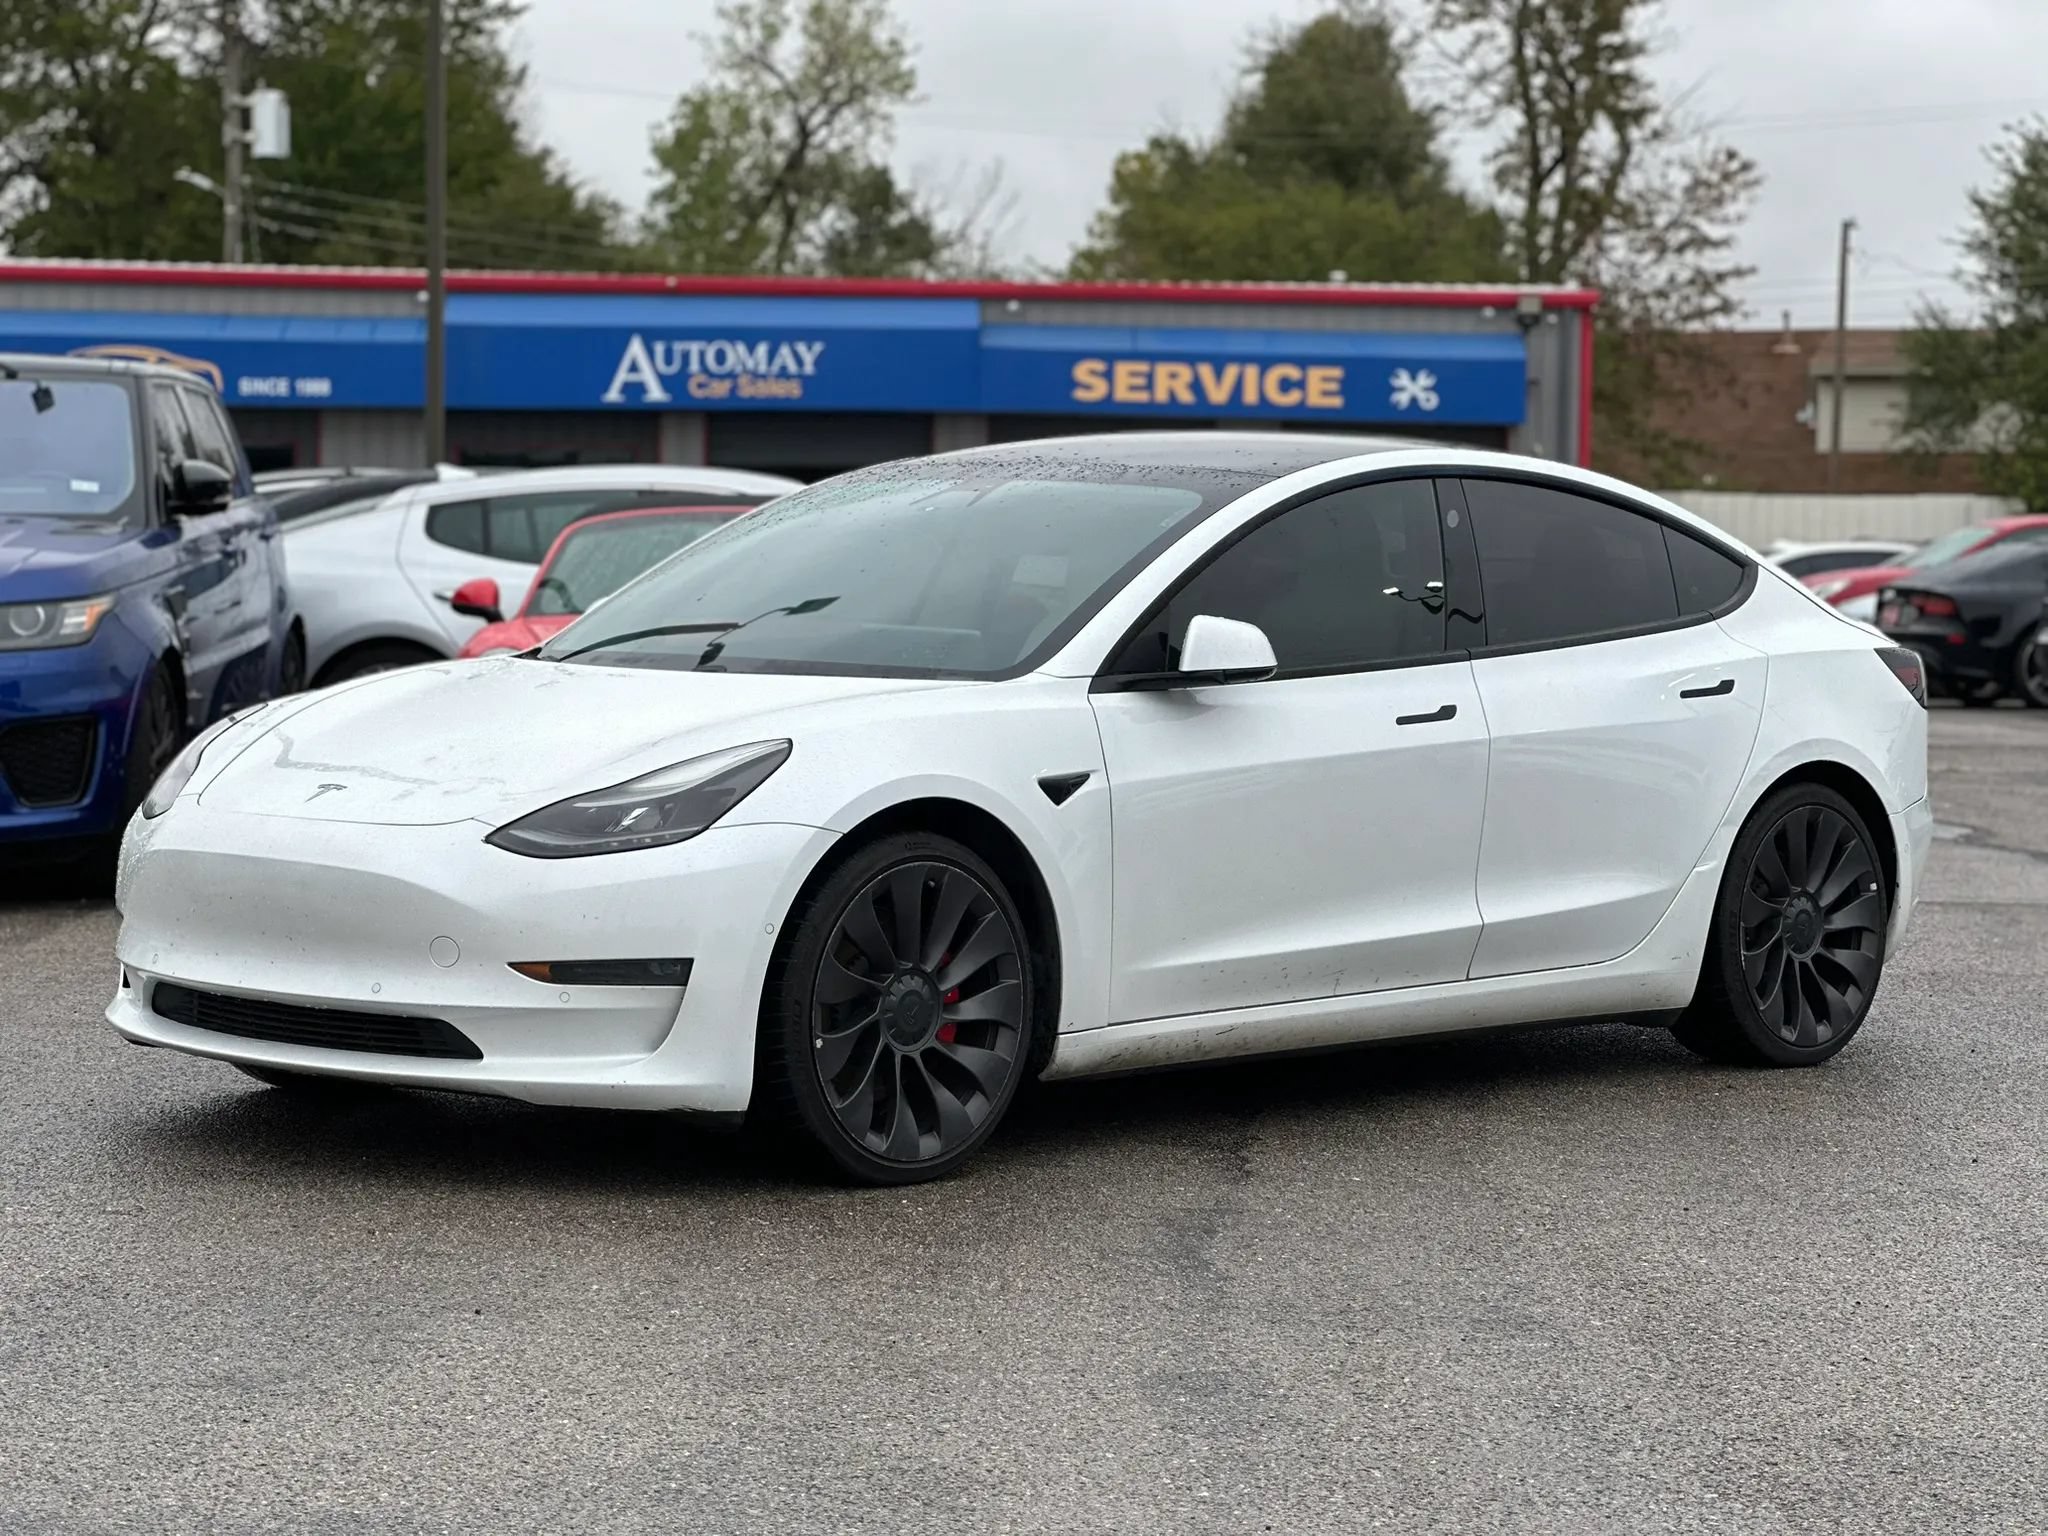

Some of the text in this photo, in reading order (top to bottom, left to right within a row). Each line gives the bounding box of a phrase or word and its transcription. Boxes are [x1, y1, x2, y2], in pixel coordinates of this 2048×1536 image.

[601, 333, 824, 403] AUTOMAY
[687, 373, 803, 398] Car Sales
[1071, 358, 1345, 408] SERVICE
[238, 376, 290, 398] SINCE
